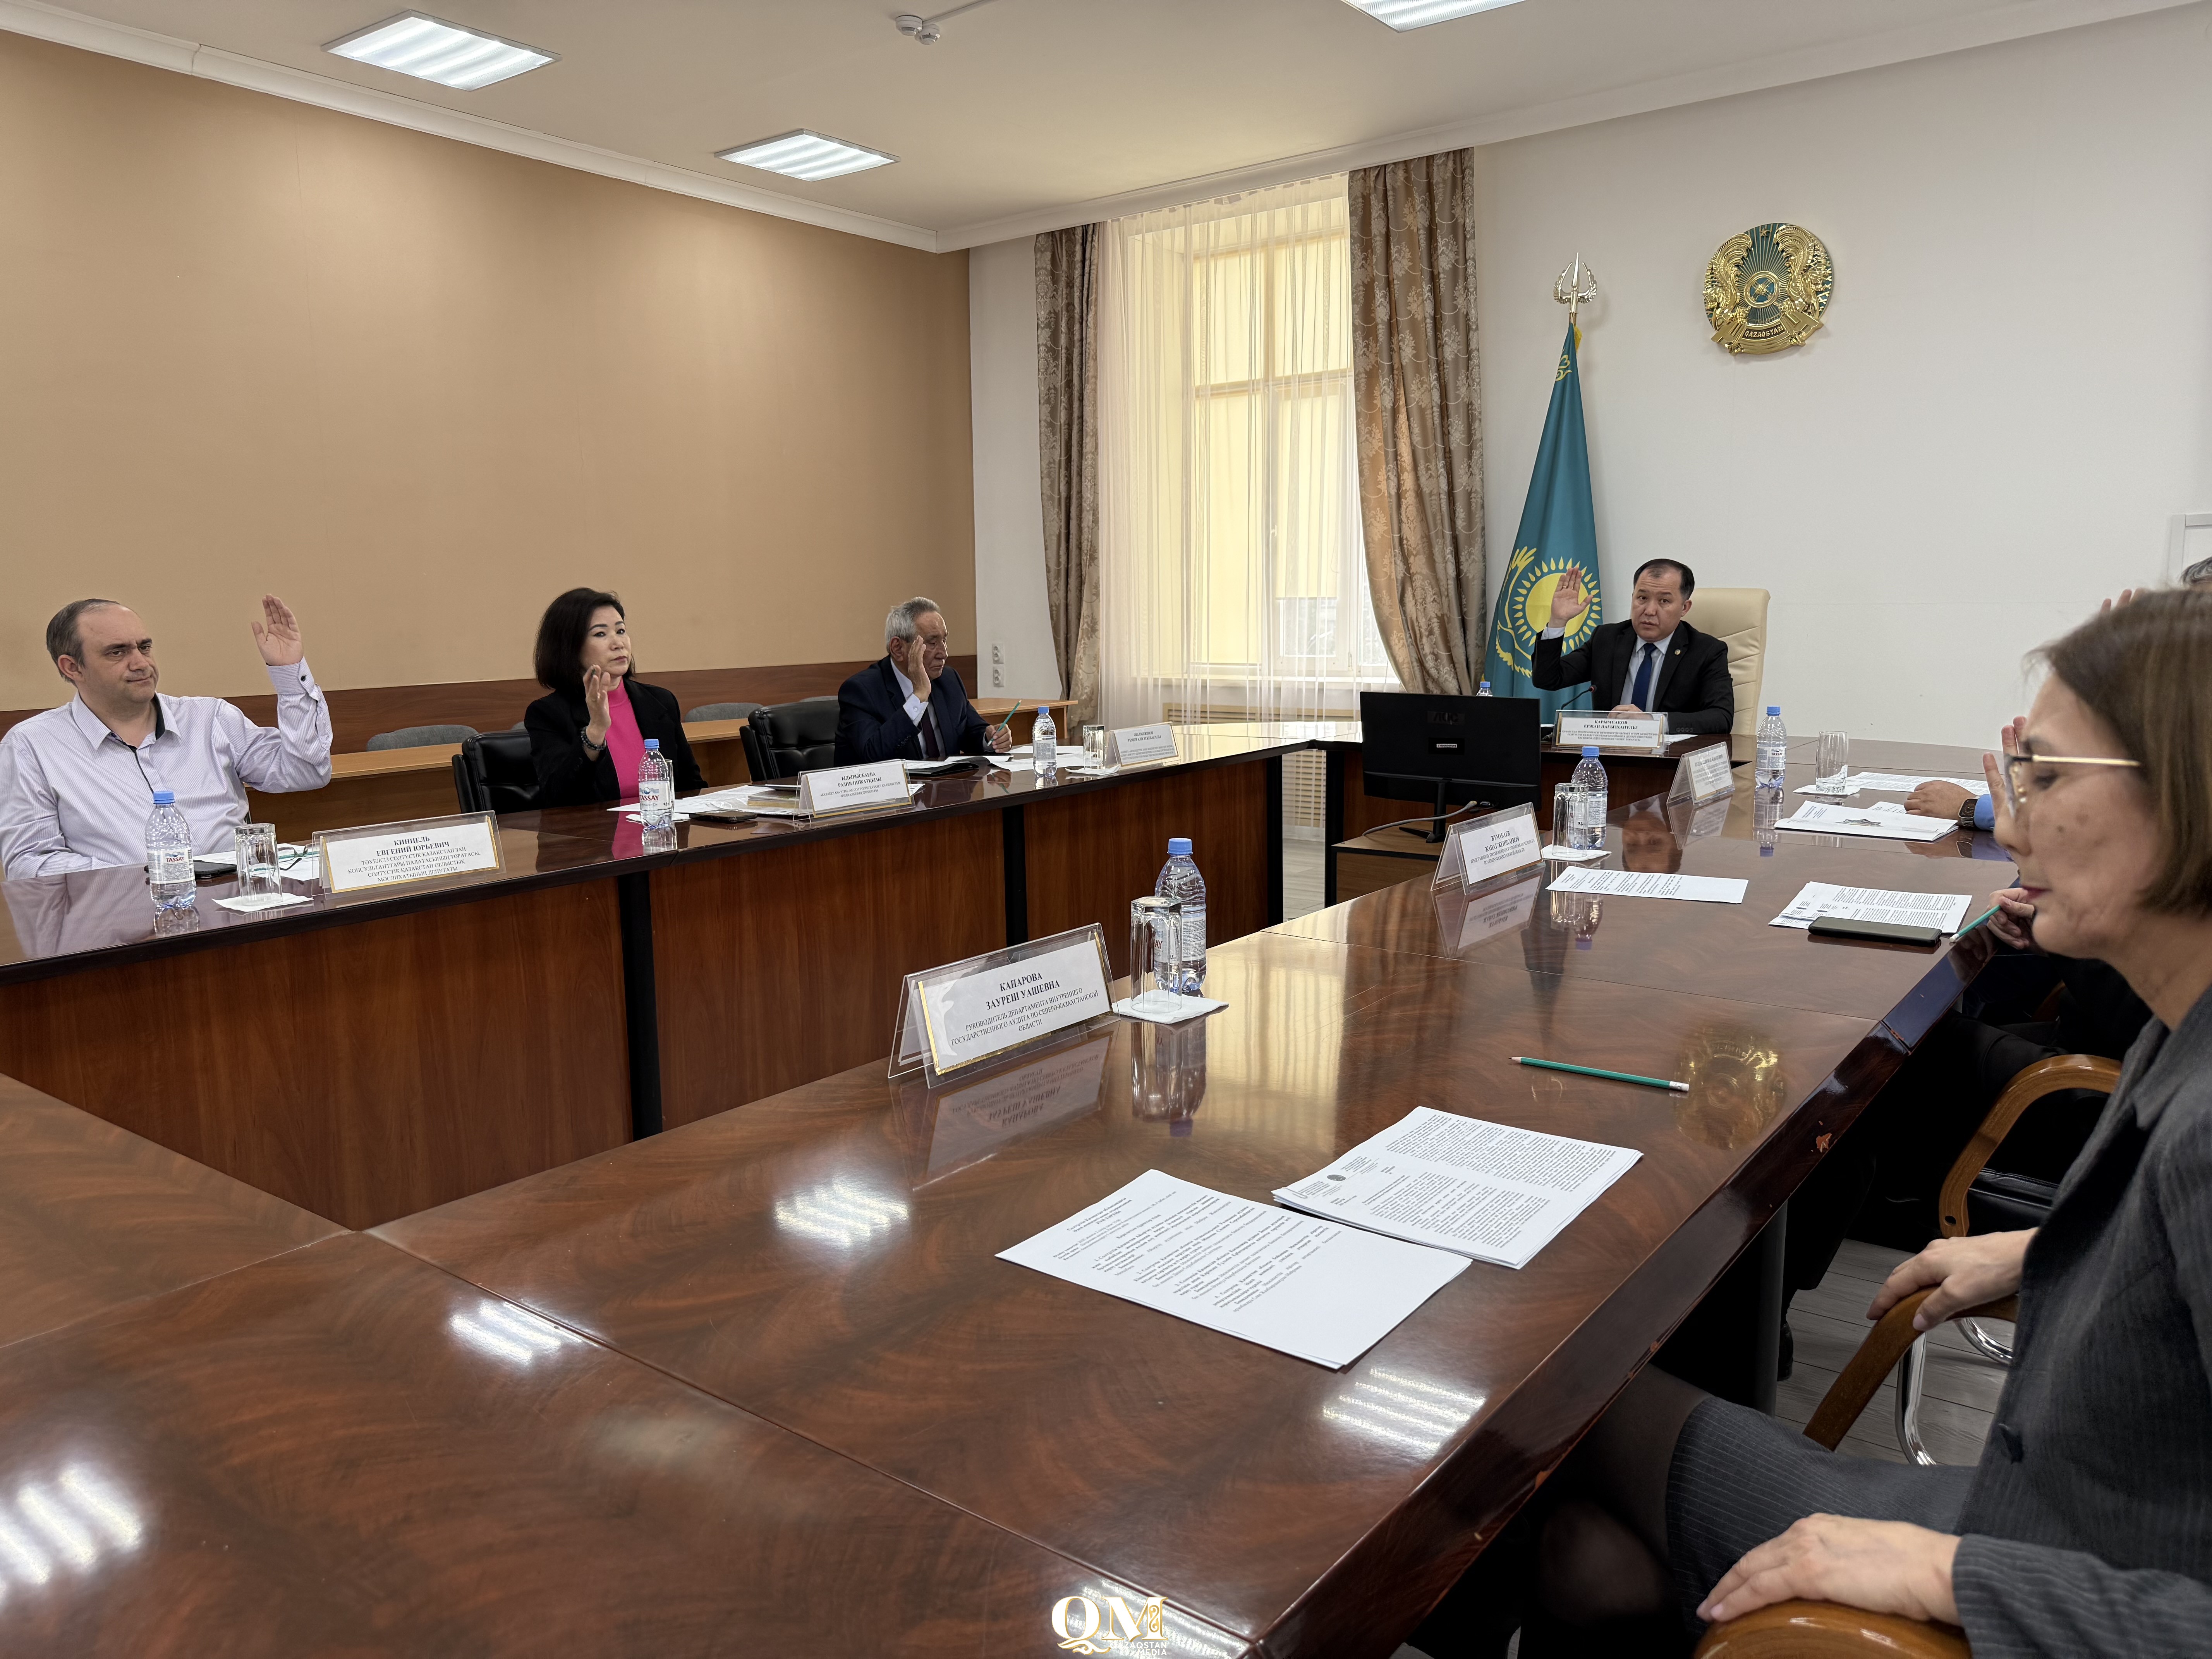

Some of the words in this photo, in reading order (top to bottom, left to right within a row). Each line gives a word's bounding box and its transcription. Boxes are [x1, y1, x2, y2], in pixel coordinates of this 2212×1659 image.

[1745, 326, 1783, 338] QAZAQSTAN
[394, 836, 430, 846] КИНЦЕЛЬ
[376, 846, 411, 856] ЕВГЕНИЙ
[414, 842, 449, 851] ЮРЬЕВИЧ
[348, 861, 405, 874] КОНСУЛЬТАНТТАРЫ
[428, 866, 458, 876] ДЕПУТАТЫ
[1000, 972, 1042, 992] КАПАРОВА
[986, 992, 1019, 1010] ЗАУРЕШ
[1020, 980, 1060, 998] УАШЕВНА
[965, 1012, 1007, 1032] РУКОВОДИТЕЛЬ
[1008, 1000, 1048, 1018] ДЕПАРТАМЕНТА
[1049, 988, 1083, 1003] ВНУТРЕННЕГО
[951, 1021, 1008, 1046] ГОСУДАРСТВЕННОГО
[1009, 1015, 1030, 1026] АУДИТА
[1039, 990, 1099, 1015] СЕВЕРО-КАЗАХСТАНСКОЙ
[1018, 1019, 1042, 1032] ОБЛАСТИ
